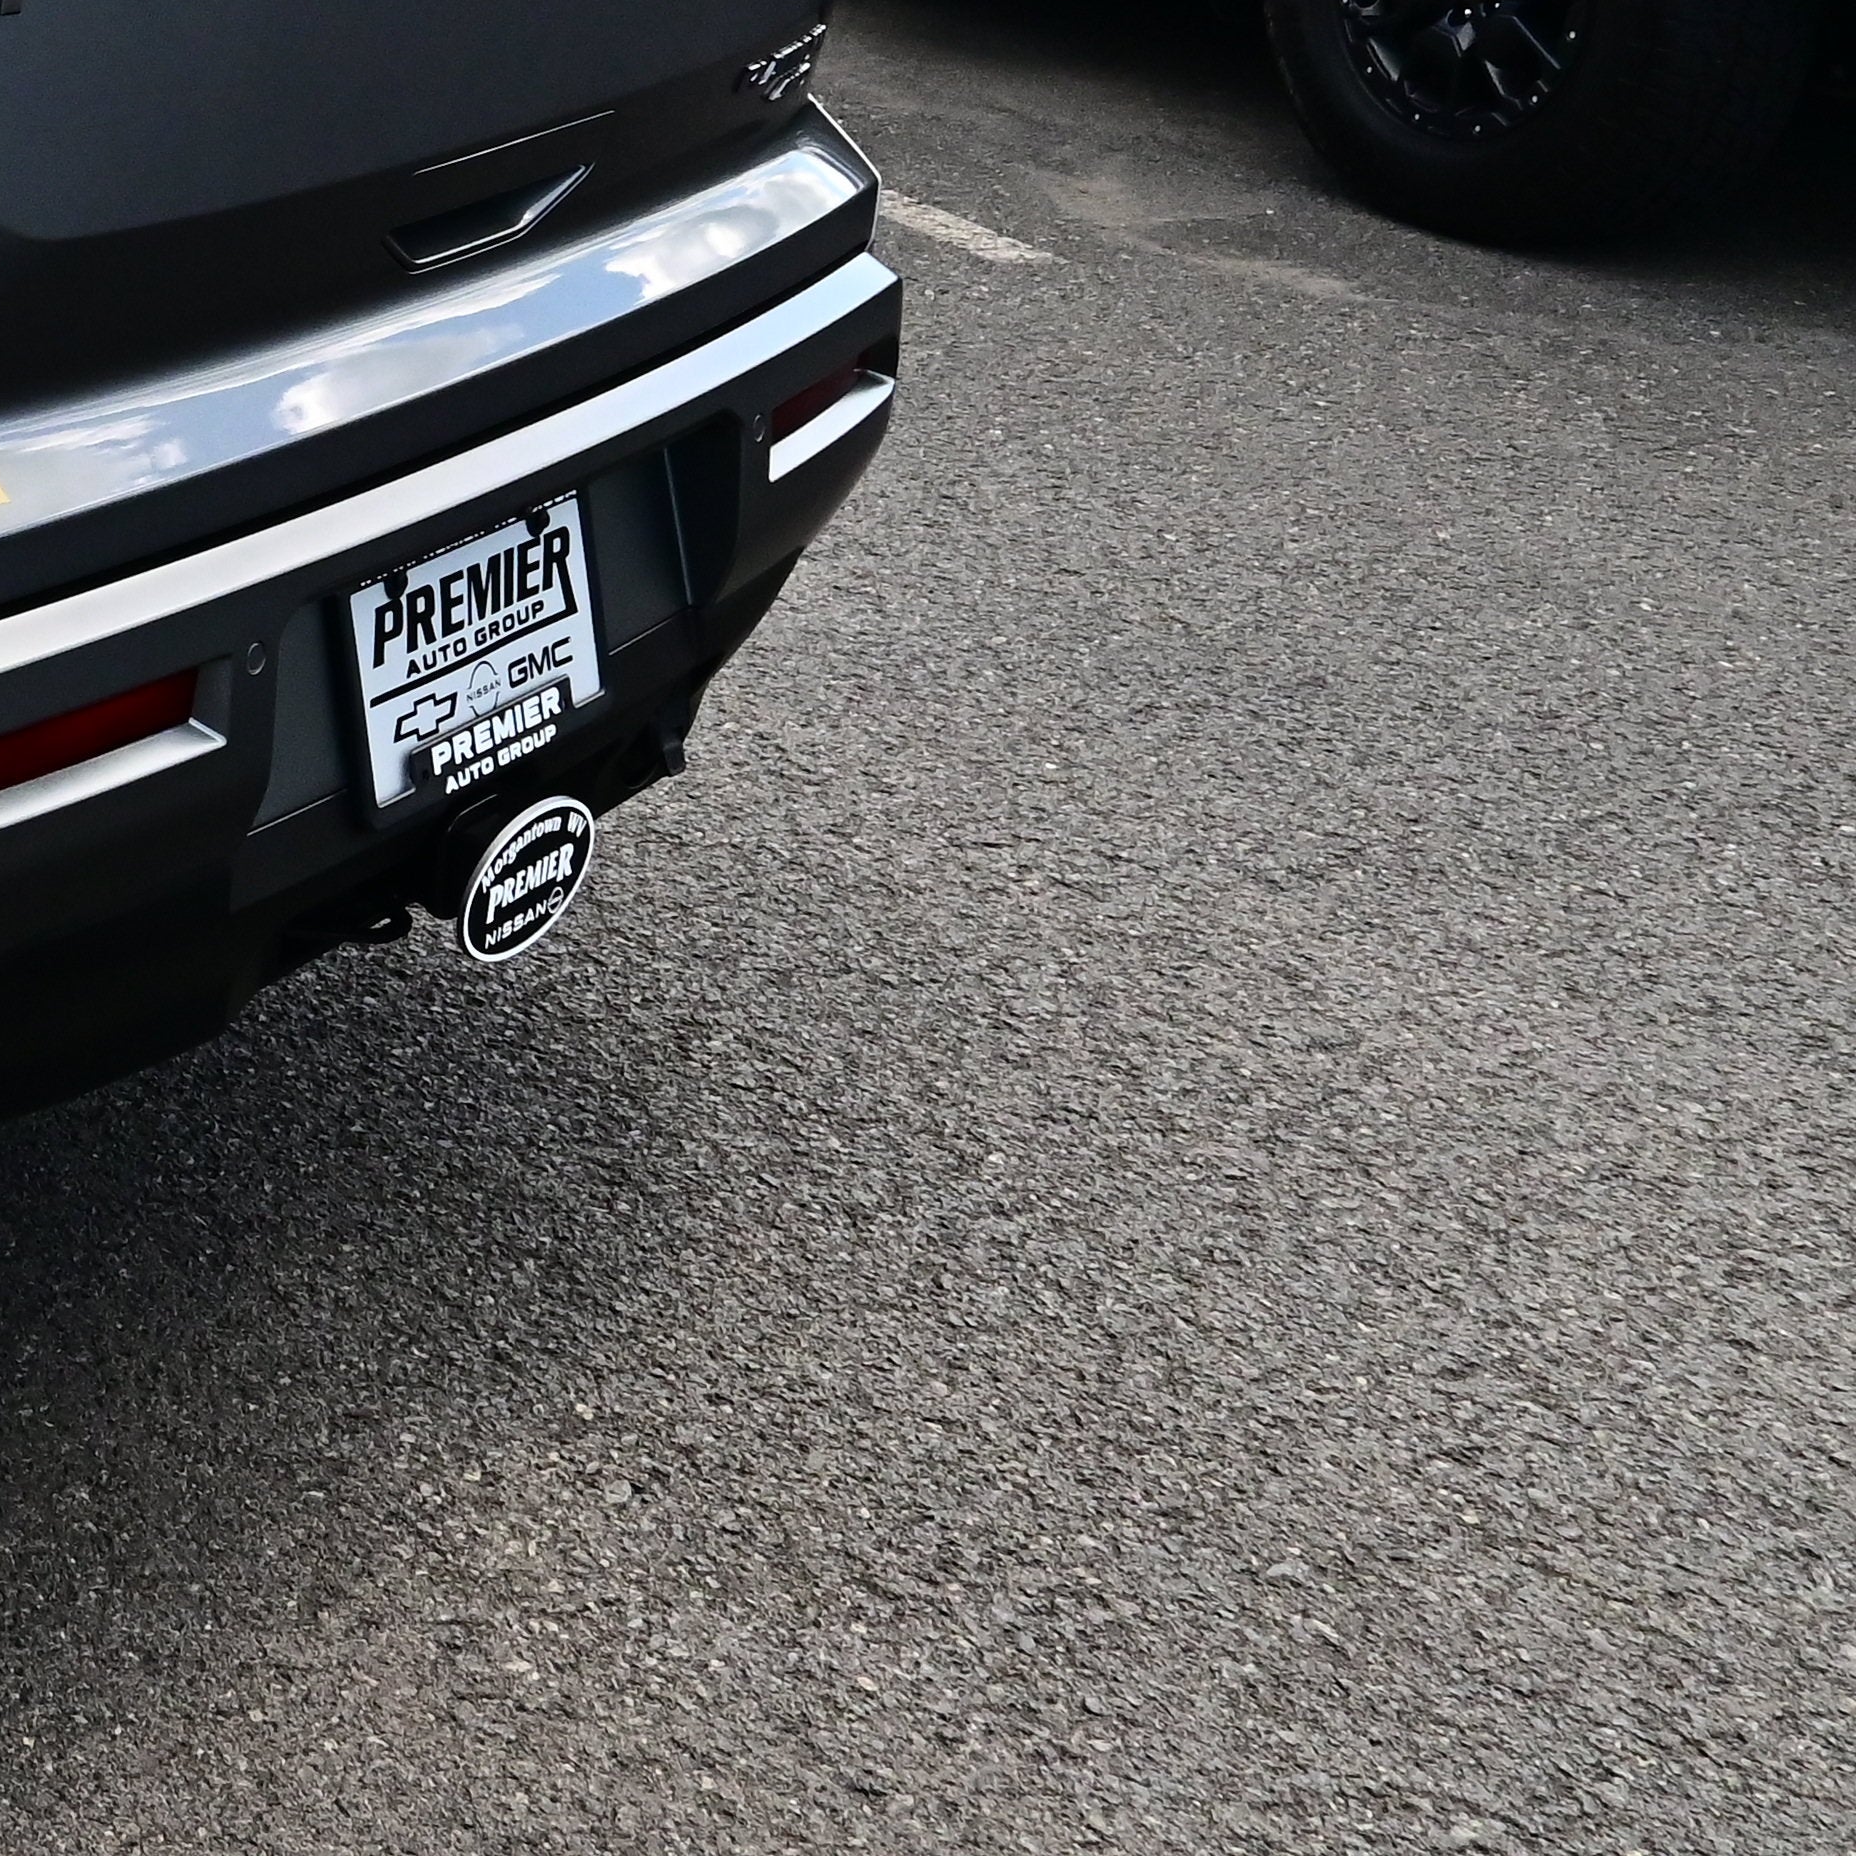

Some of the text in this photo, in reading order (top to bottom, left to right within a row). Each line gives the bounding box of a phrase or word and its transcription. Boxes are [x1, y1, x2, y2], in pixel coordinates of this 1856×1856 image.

[373, 526, 572, 670] PREMIER
[406, 600, 544, 678] AUTO GROUP
[508, 636, 573, 688] GMC
[466, 679, 501, 703] NISSAN
[431, 686, 562, 775] PREMIER
[445, 724, 557, 794] AUTO GROUP
[481, 811, 587, 894] Morgantown WV
[486, 843, 575, 925] PREMIER
[485, 900, 548, 950] NISSAN
